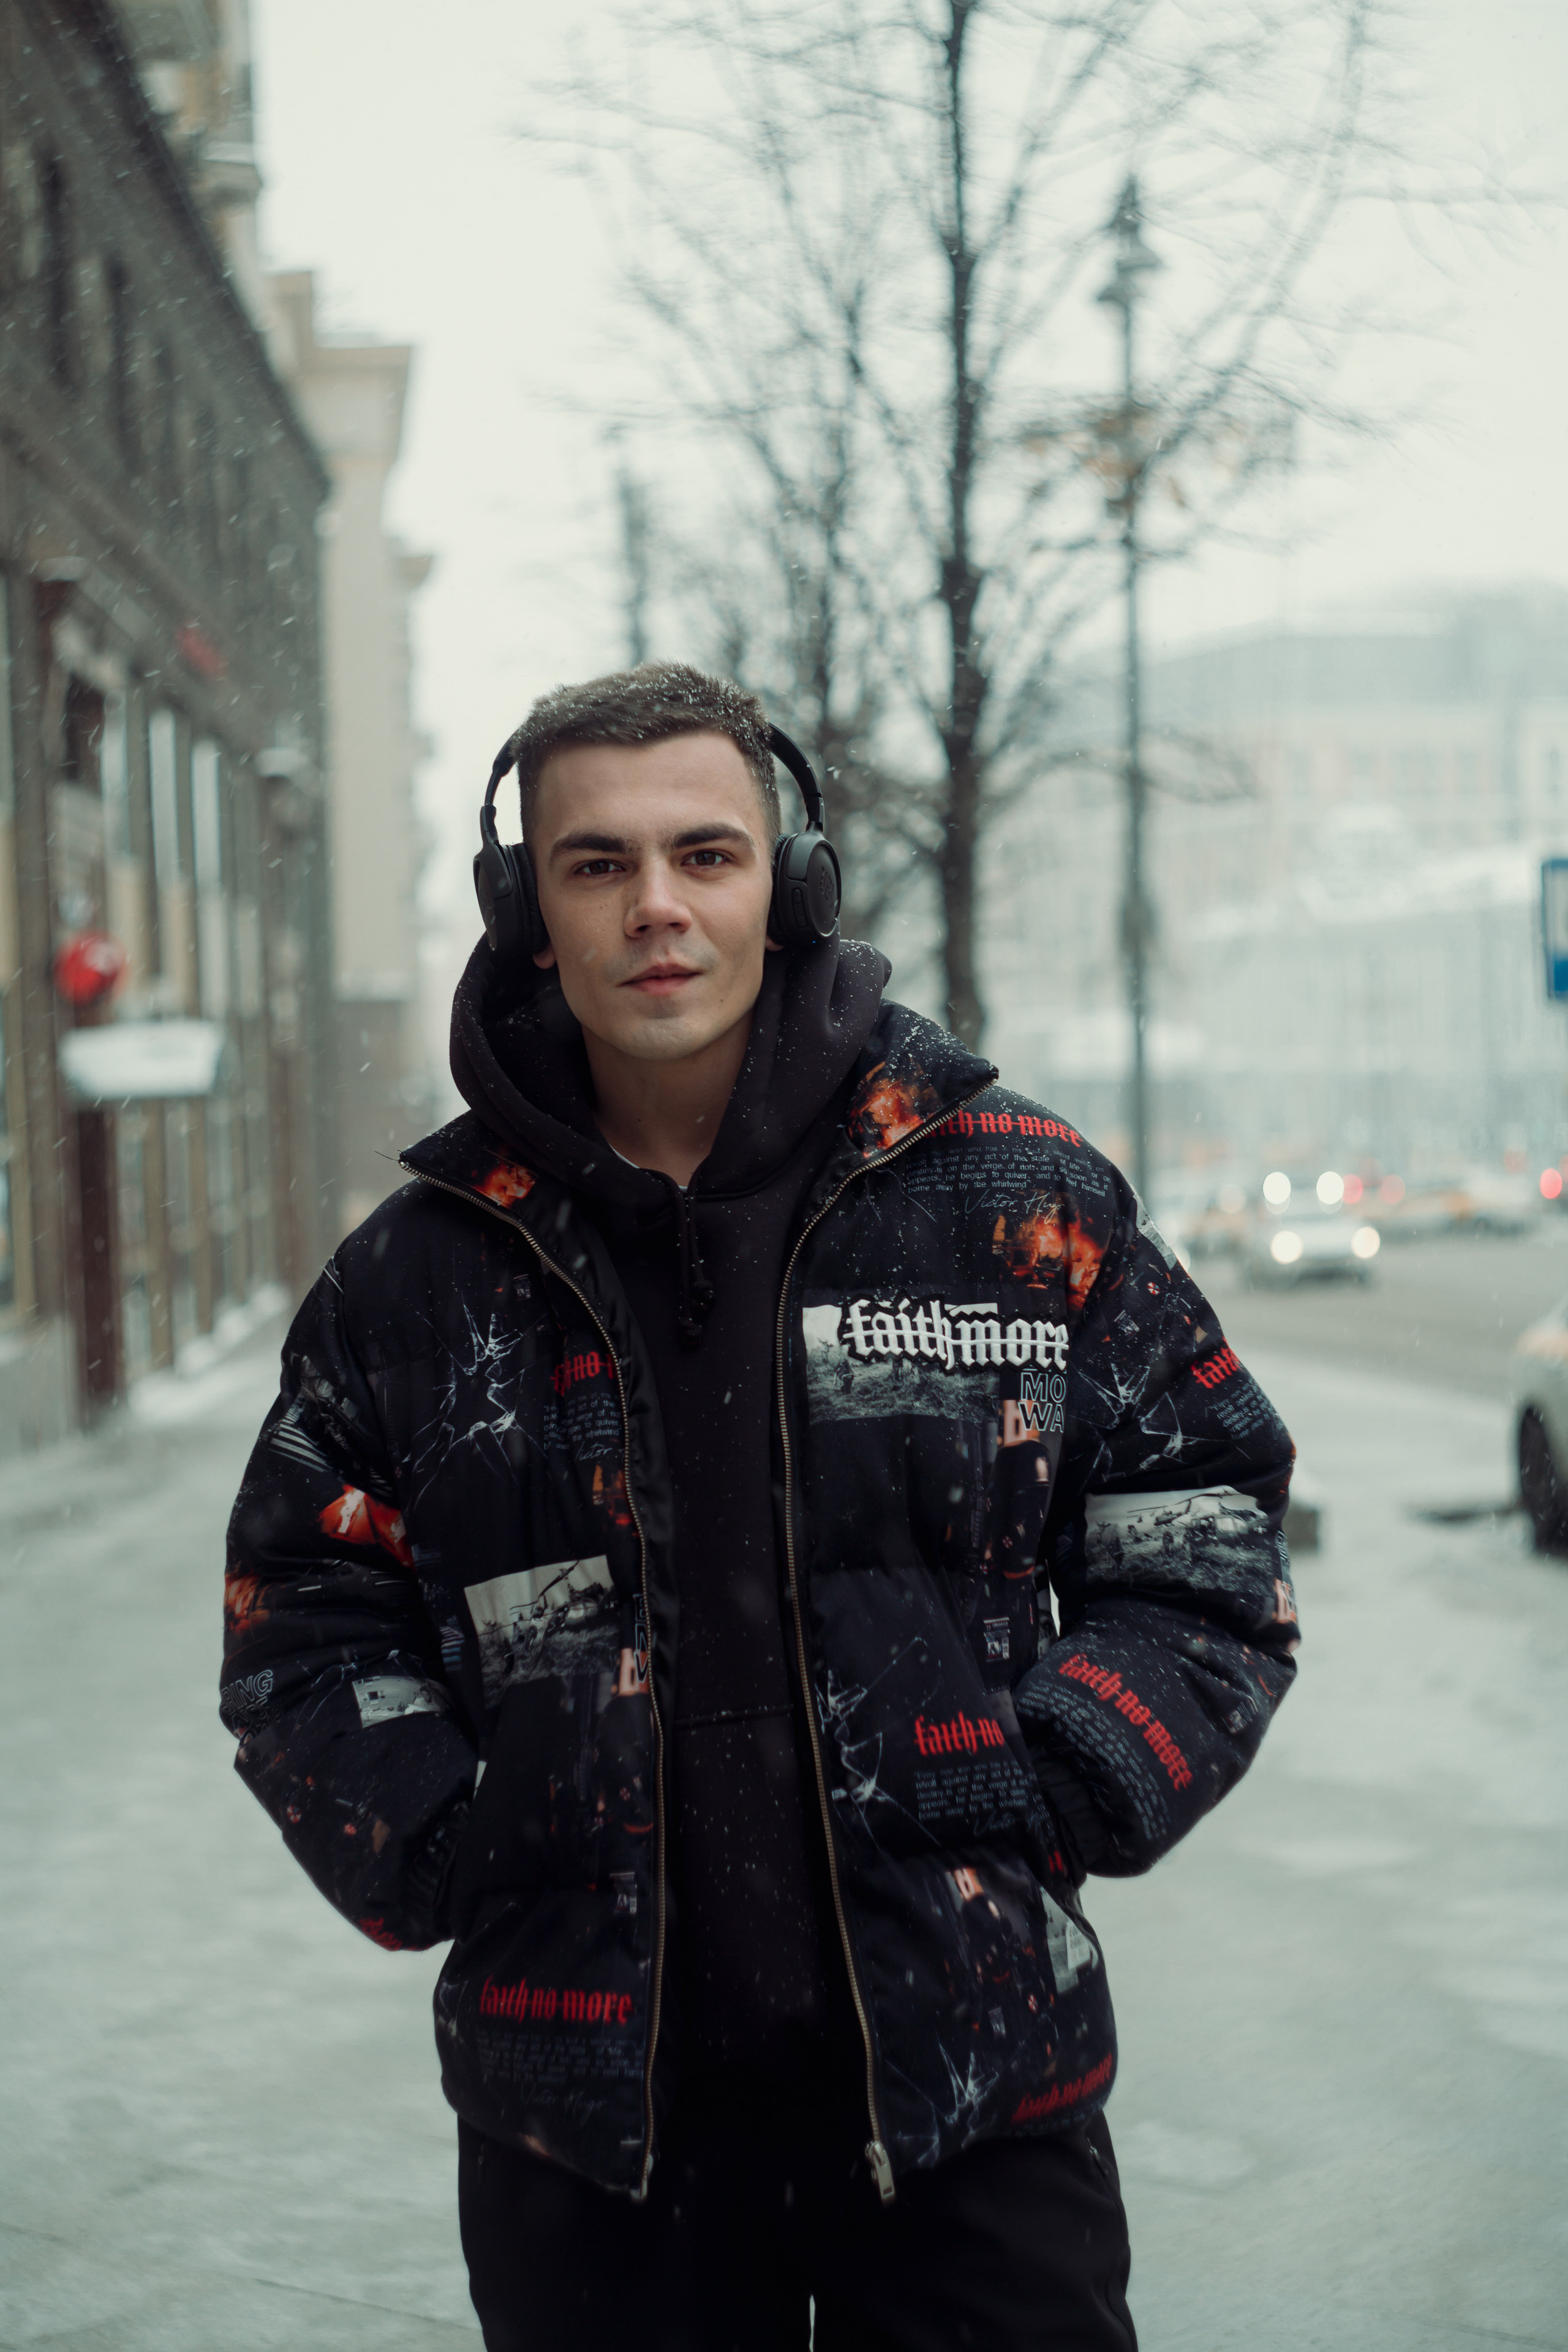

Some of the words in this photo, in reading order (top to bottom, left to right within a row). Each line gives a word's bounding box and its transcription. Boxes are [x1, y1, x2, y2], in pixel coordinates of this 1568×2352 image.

[978, 1112, 1012, 1134] no
[1018, 1114, 1084, 1148] more
[932, 1156, 959, 1166] against
[965, 1155, 979, 1163] any
[960, 1172, 987, 1180] begins
[1069, 1172, 1087, 1182] soon
[936, 1184, 954, 1193] away
[959, 1182, 968, 1191] by
[965, 1188, 1018, 1213] Victor
[1024, 1192, 1065, 1224] Hugo
[913, 1709, 979, 1757] faith
[977, 1717, 1006, 1748] no
[941, 1774, 968, 1786] against
[990, 1770, 1001, 1778] act
[1005, 1768, 1011, 1777] of
[1013, 1767, 1023, 1776] the
[1011, 1778, 1016, 1787] of
[956, 1795, 966, 1804] he
[982, 1801, 994, 1810] the
[530, 1986, 557, 2021] no
[562, 1989, 635, 2027] more
